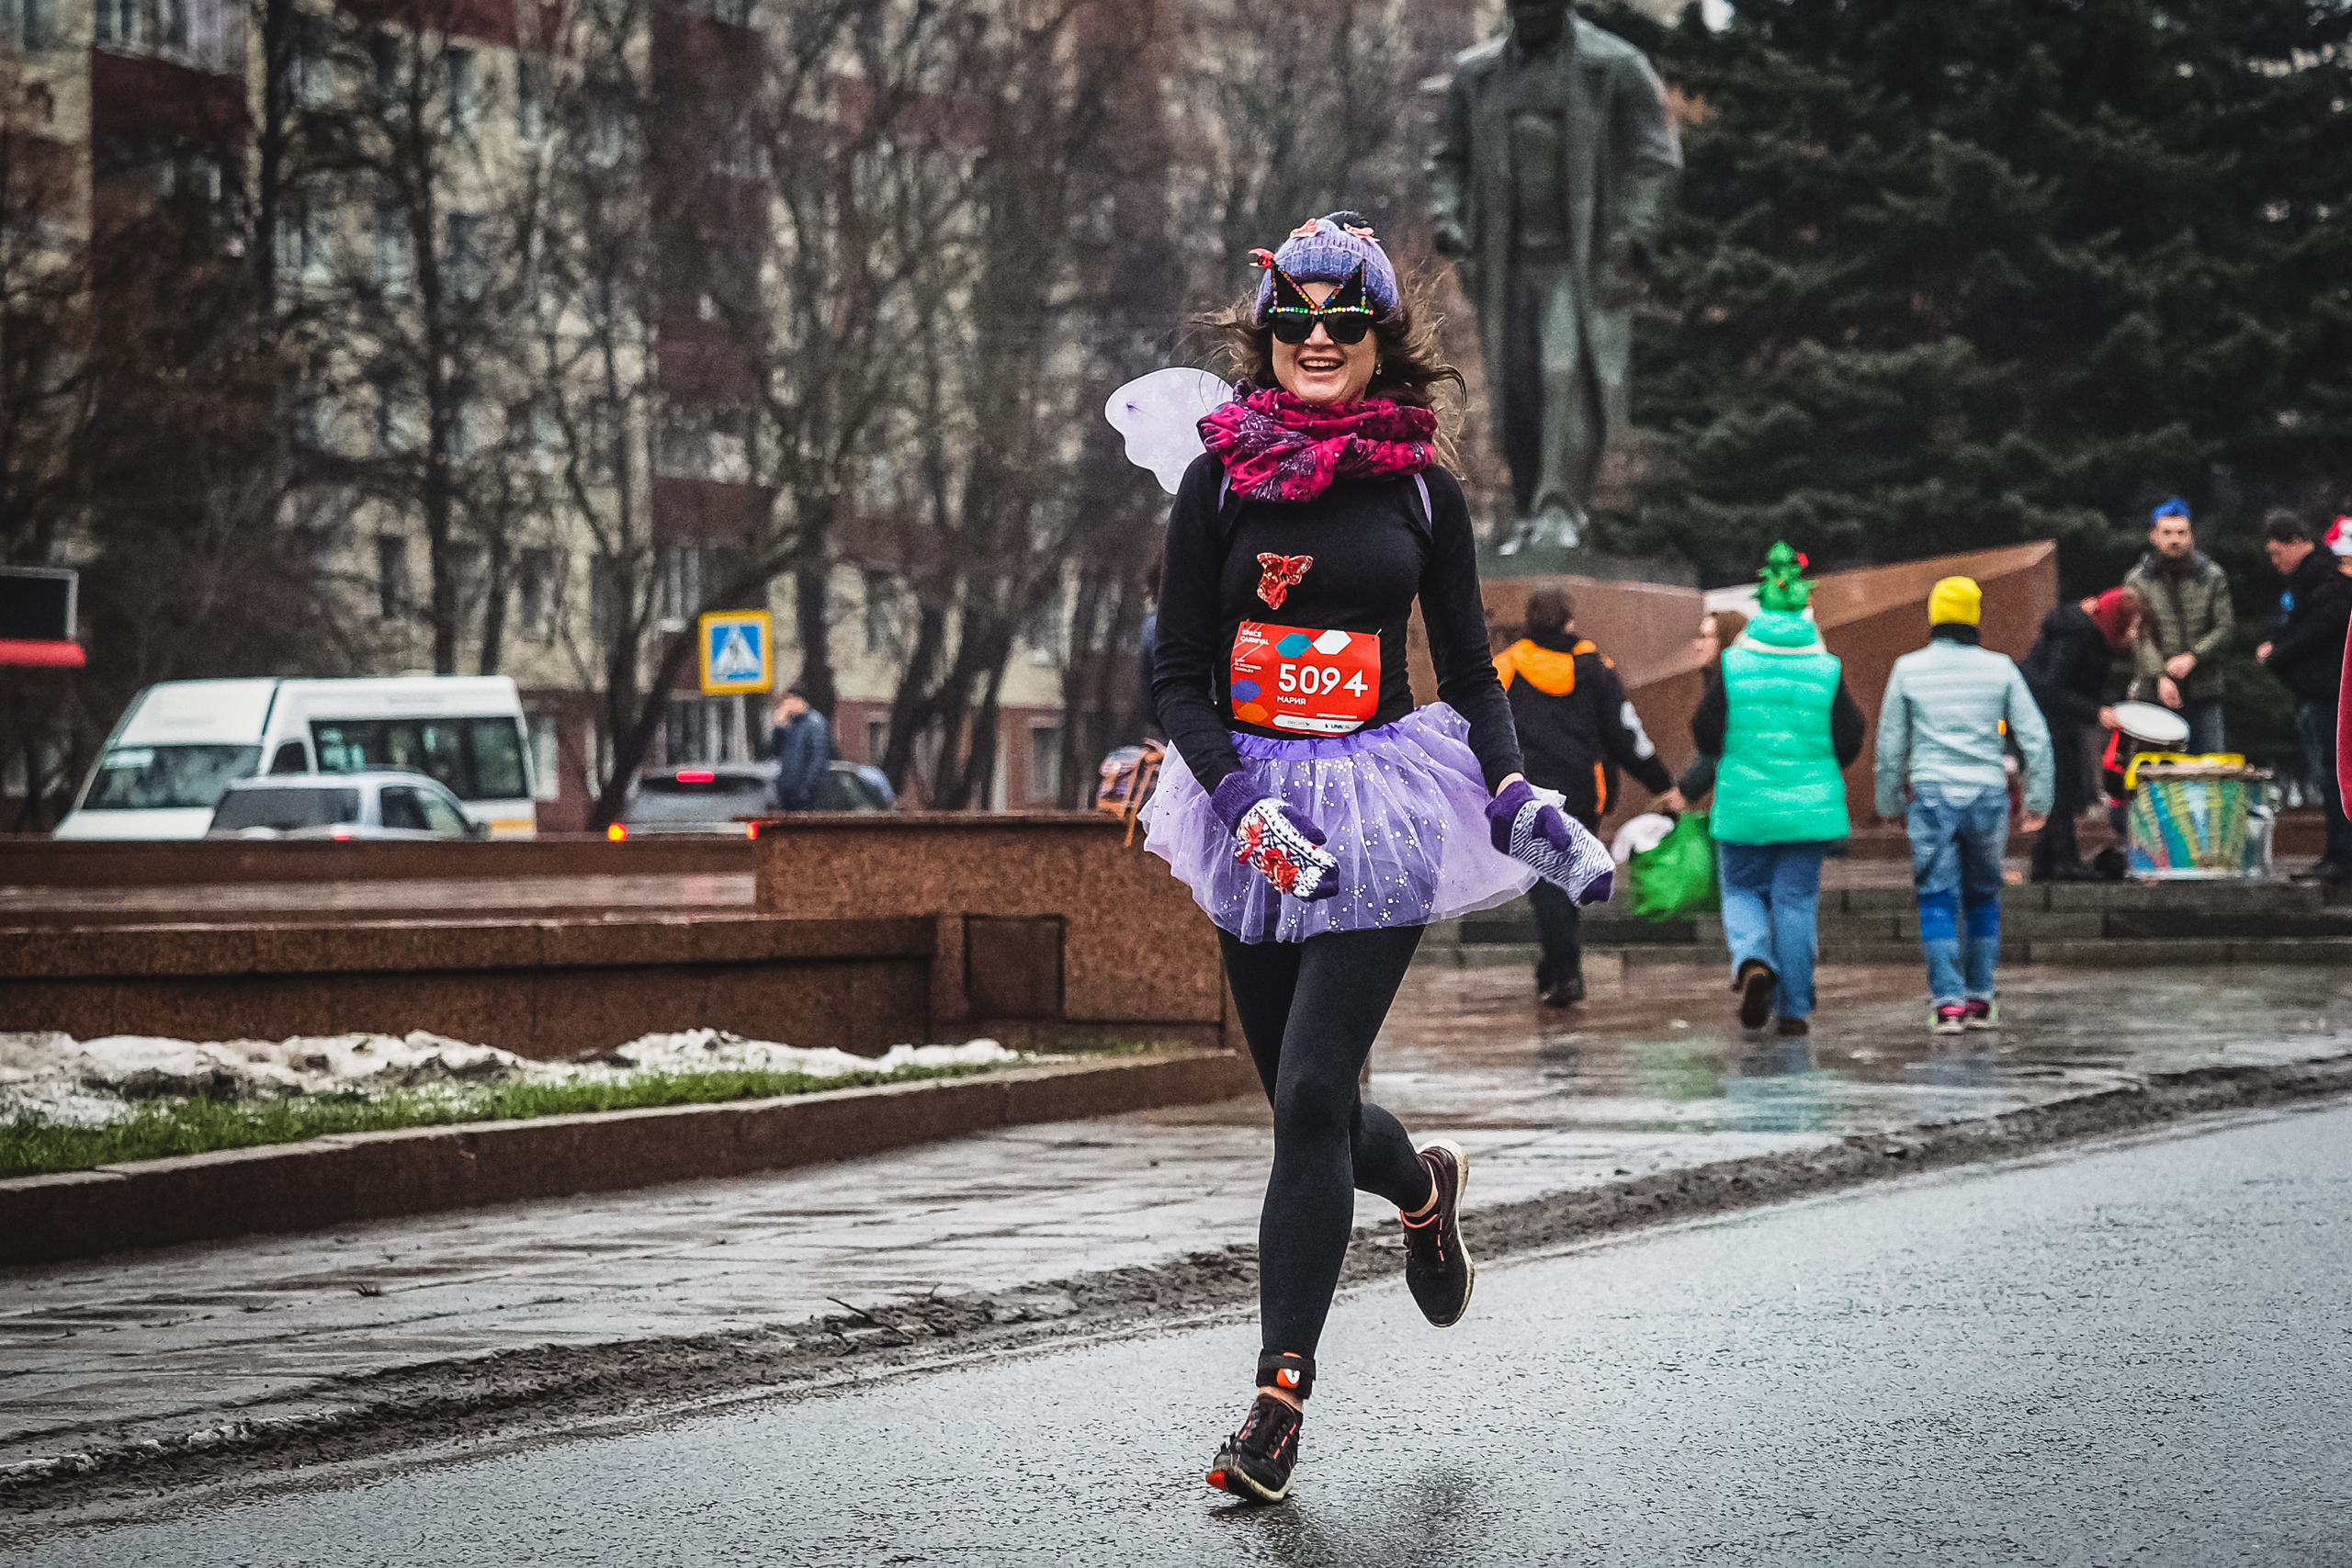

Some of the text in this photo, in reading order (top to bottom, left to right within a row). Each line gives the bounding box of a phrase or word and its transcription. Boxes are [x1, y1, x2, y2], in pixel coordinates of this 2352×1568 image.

[1241, 629, 1262, 638] SPACE
[1239, 636, 1270, 646] CARNIVAL
[1278, 662, 1369, 698] 5094
[1277, 694, 1306, 705] МАРИЯ
